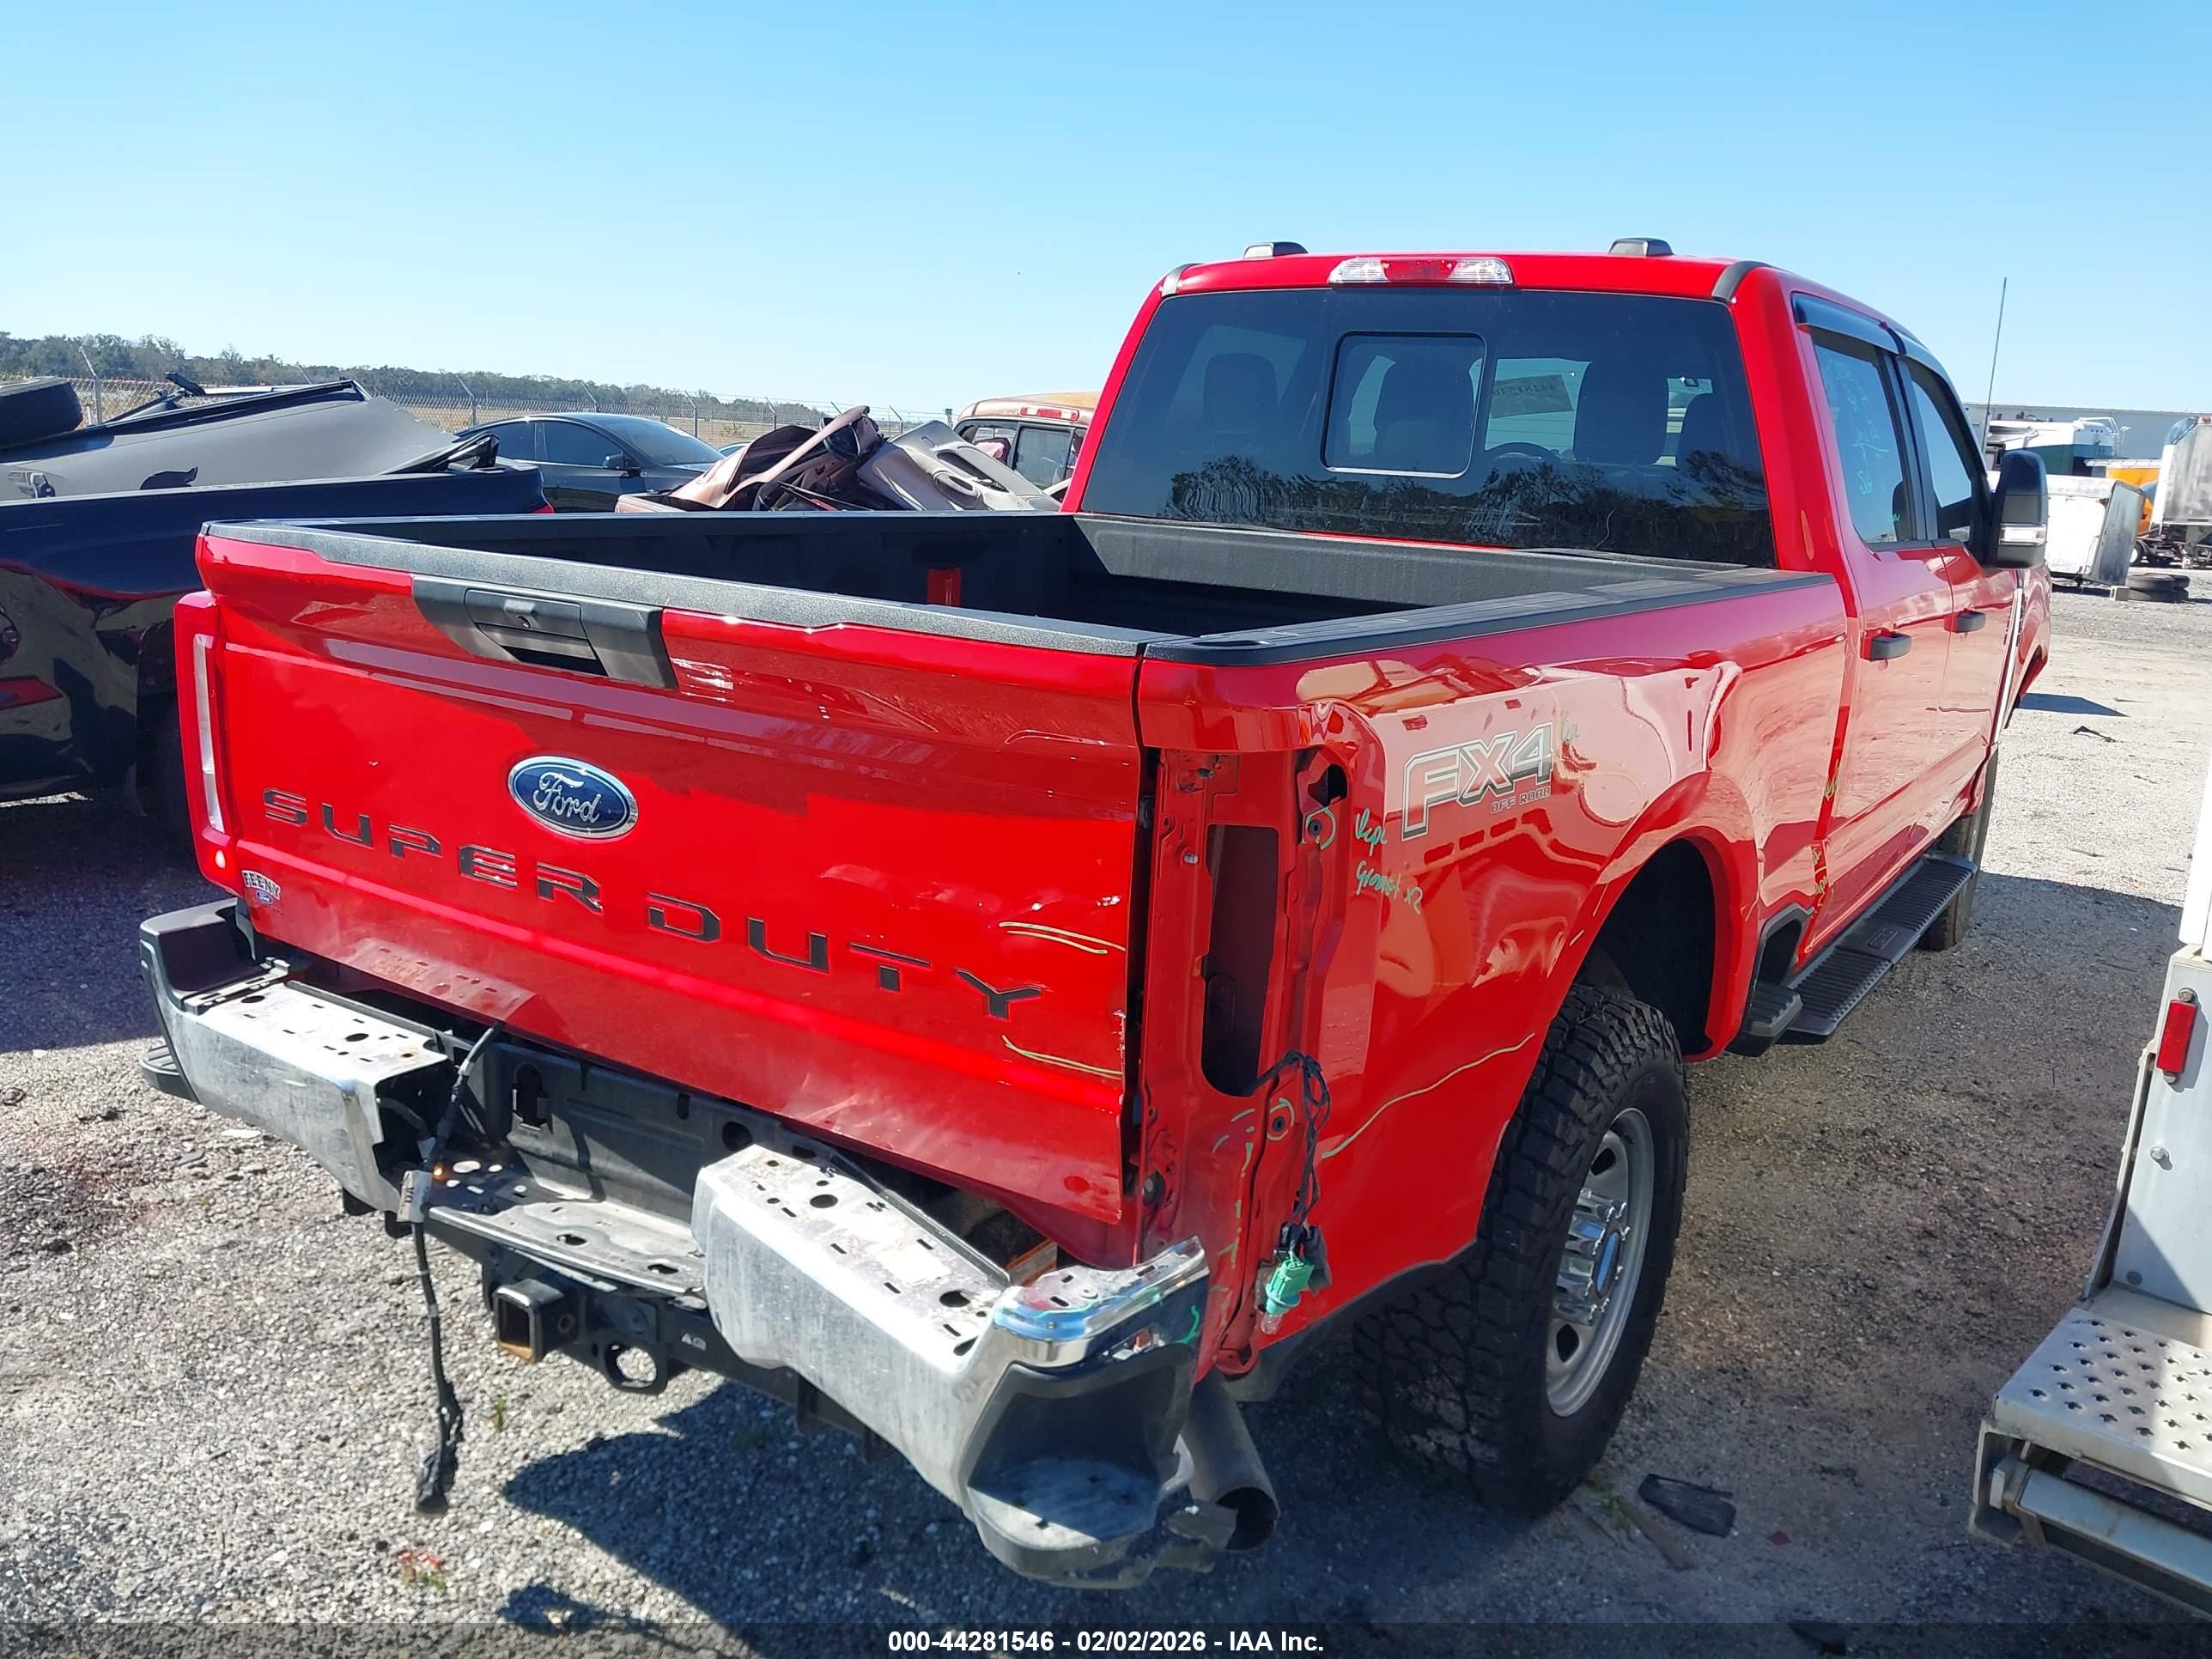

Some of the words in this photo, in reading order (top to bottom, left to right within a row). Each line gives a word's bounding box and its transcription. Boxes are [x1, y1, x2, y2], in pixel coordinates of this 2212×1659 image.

[532, 771, 603, 823] Ford
[1401, 722, 1553, 842] FX4
[1491, 796, 1516, 815] OFF
[1519, 787, 1551, 805] ROAD
[243, 872, 280, 897] FEENY
[264, 788, 604, 913] SUPER
[647, 891, 1043, 1021] DUTY
